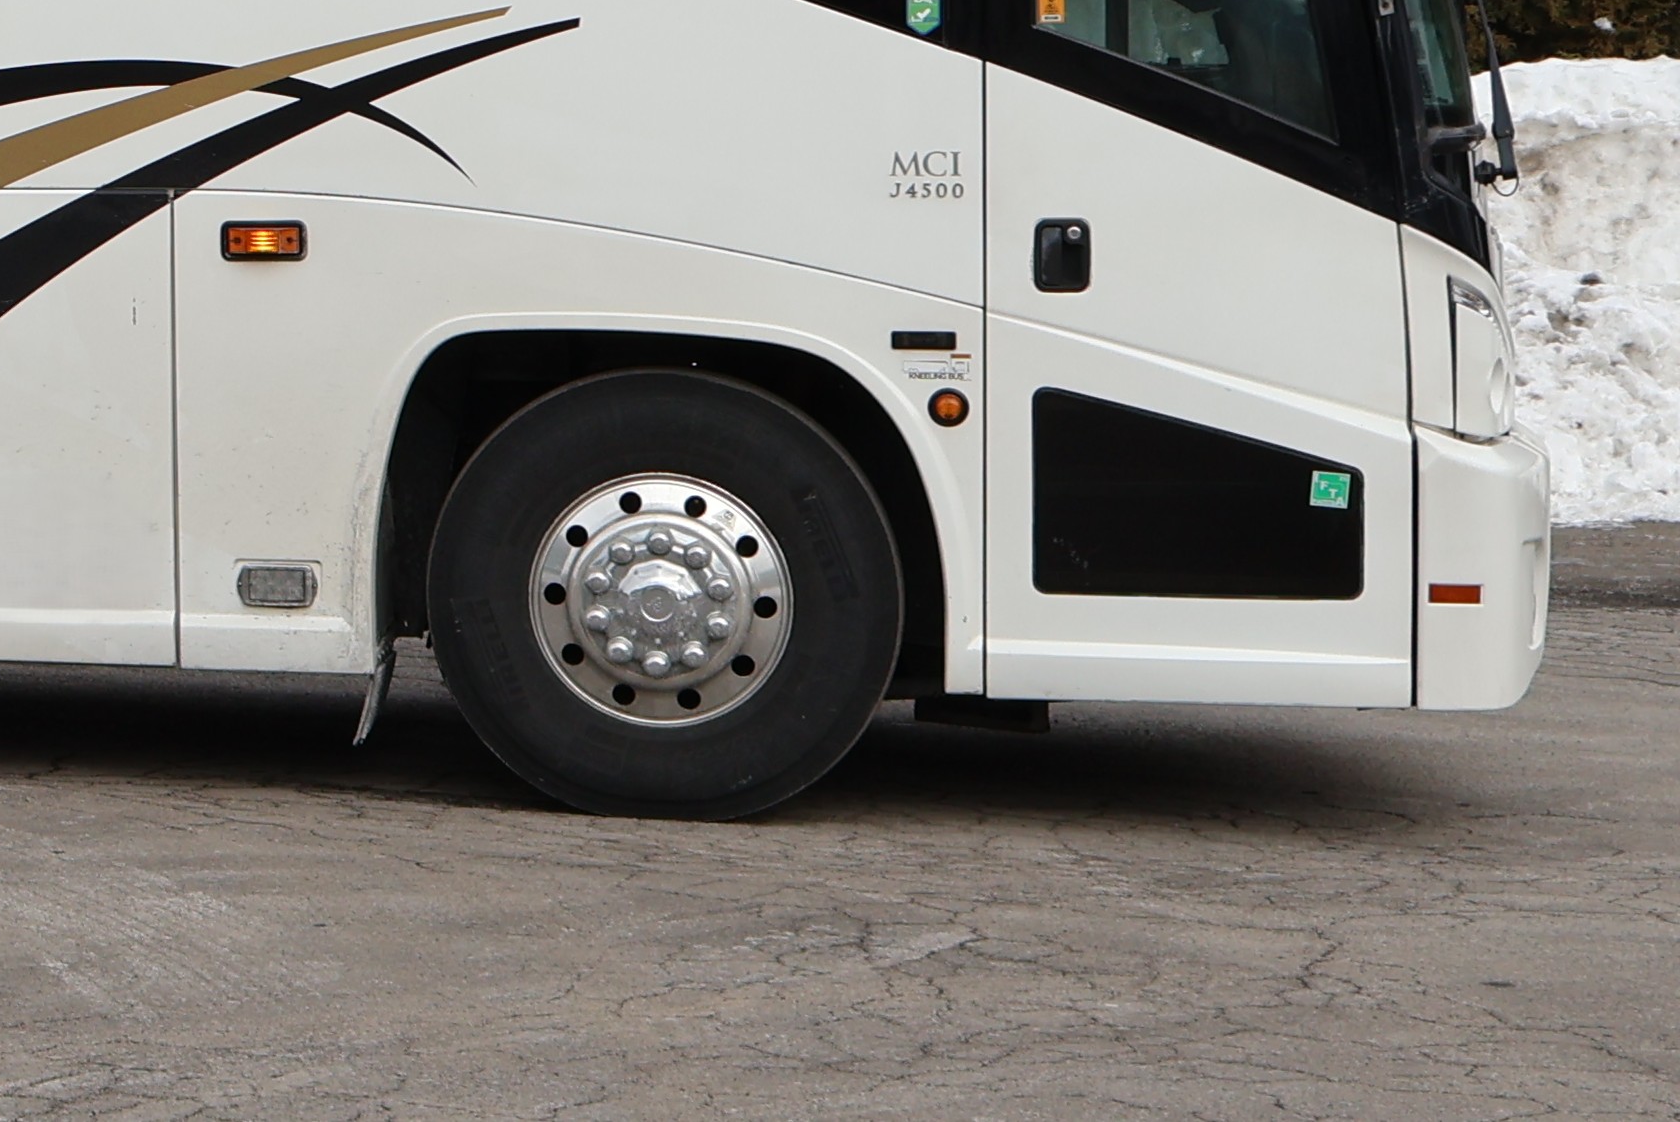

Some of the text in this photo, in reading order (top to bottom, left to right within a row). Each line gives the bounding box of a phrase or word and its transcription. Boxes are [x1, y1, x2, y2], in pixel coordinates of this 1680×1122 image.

[889, 150, 962, 177] MCI
[889, 182, 964, 199] J4500
[908, 371, 964, 380] KNEELING BUS
